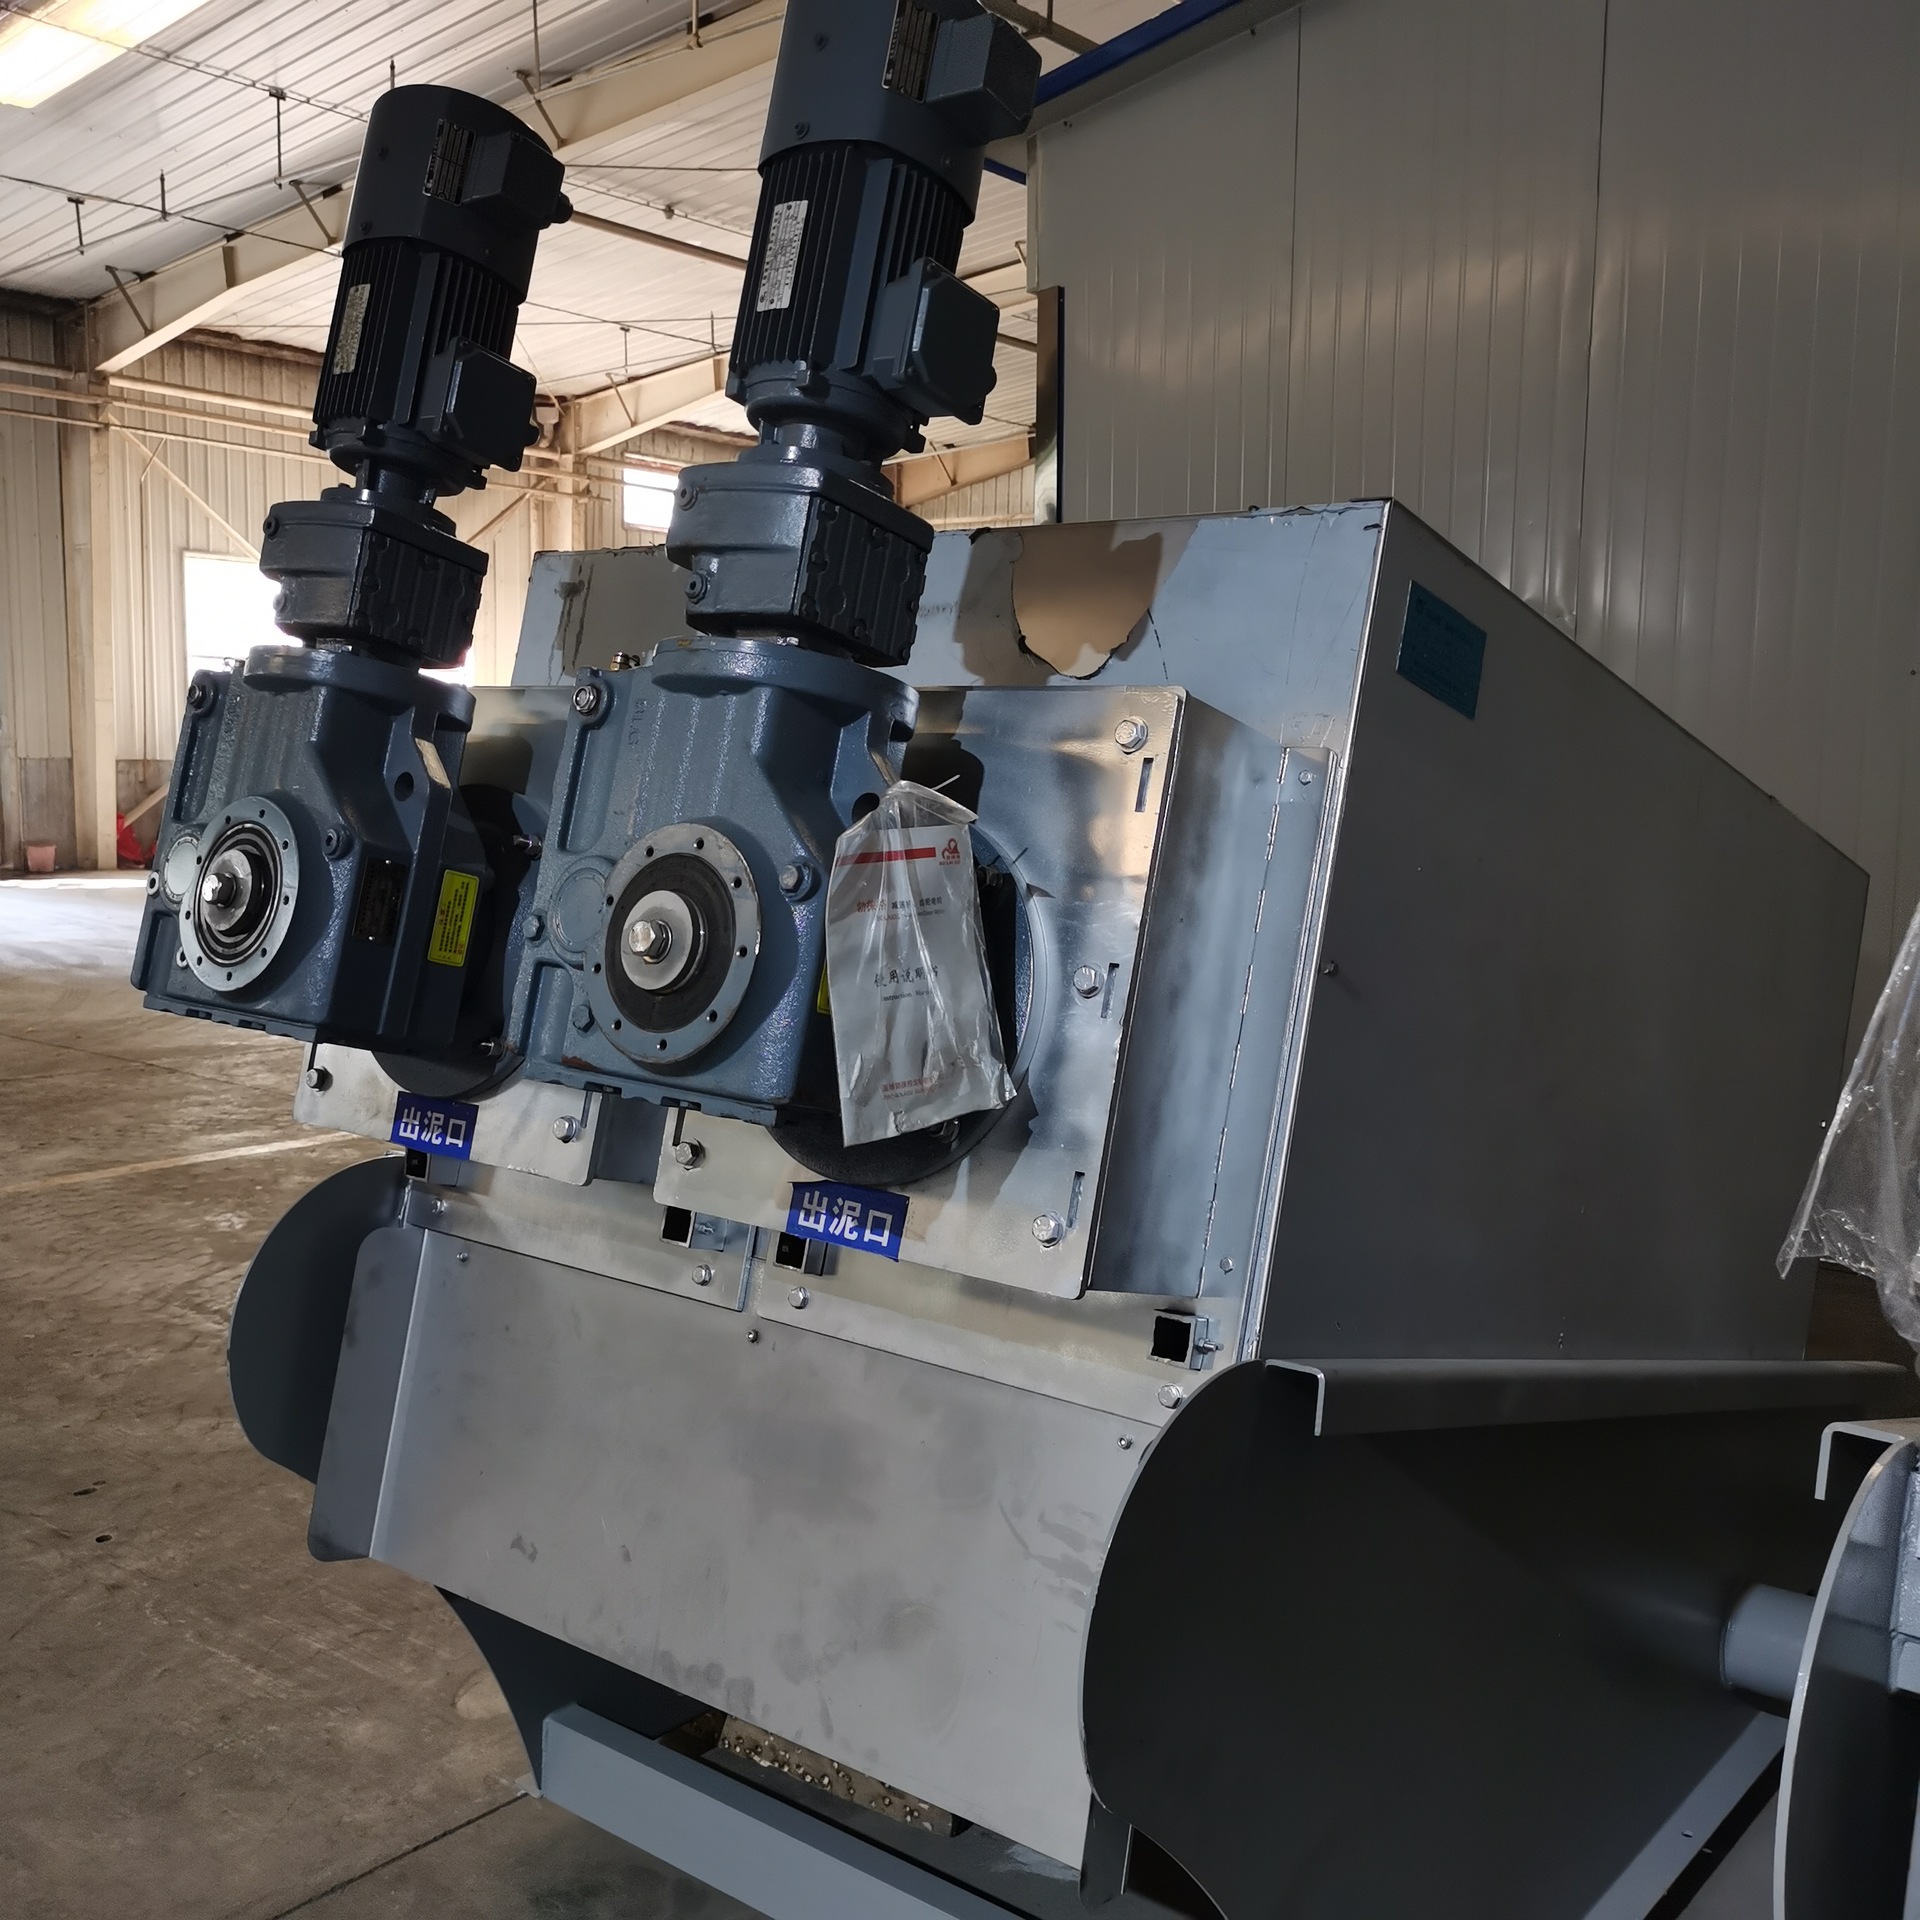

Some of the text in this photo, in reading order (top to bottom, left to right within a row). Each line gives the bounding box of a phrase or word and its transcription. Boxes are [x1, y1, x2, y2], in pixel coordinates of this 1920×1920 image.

[399, 1106, 467, 1148] 出泥口
[798, 1190, 893, 1247] 出泥口
